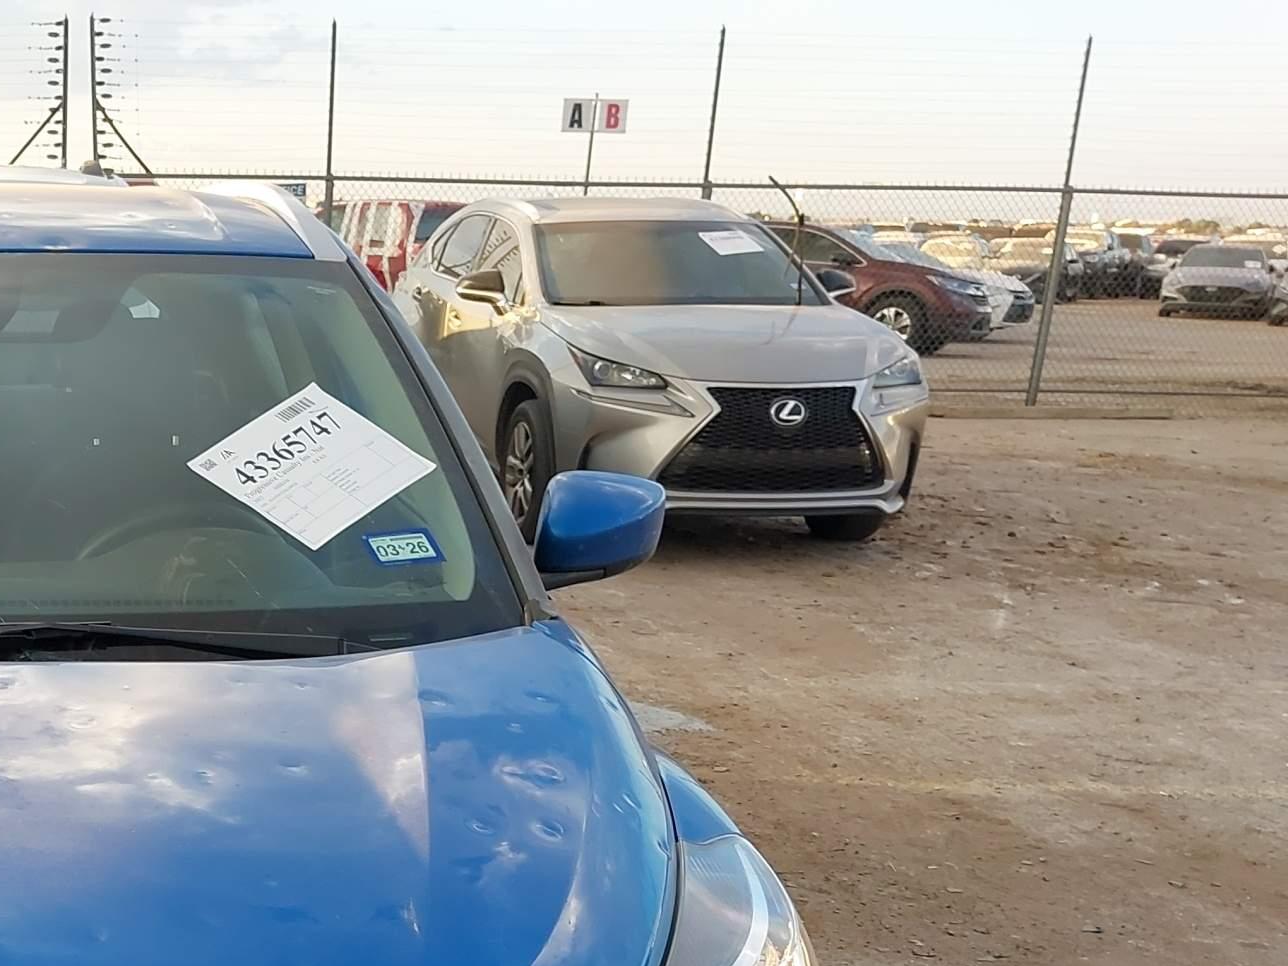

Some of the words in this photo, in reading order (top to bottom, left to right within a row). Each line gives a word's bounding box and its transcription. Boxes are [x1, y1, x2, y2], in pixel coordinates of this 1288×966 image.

[568, 103, 583, 129] A
[605, 103, 620, 129] B
[234, 411, 341, 485] 43365747
[376, 543, 400, 557] 03
[406, 541, 429, 554] 26
